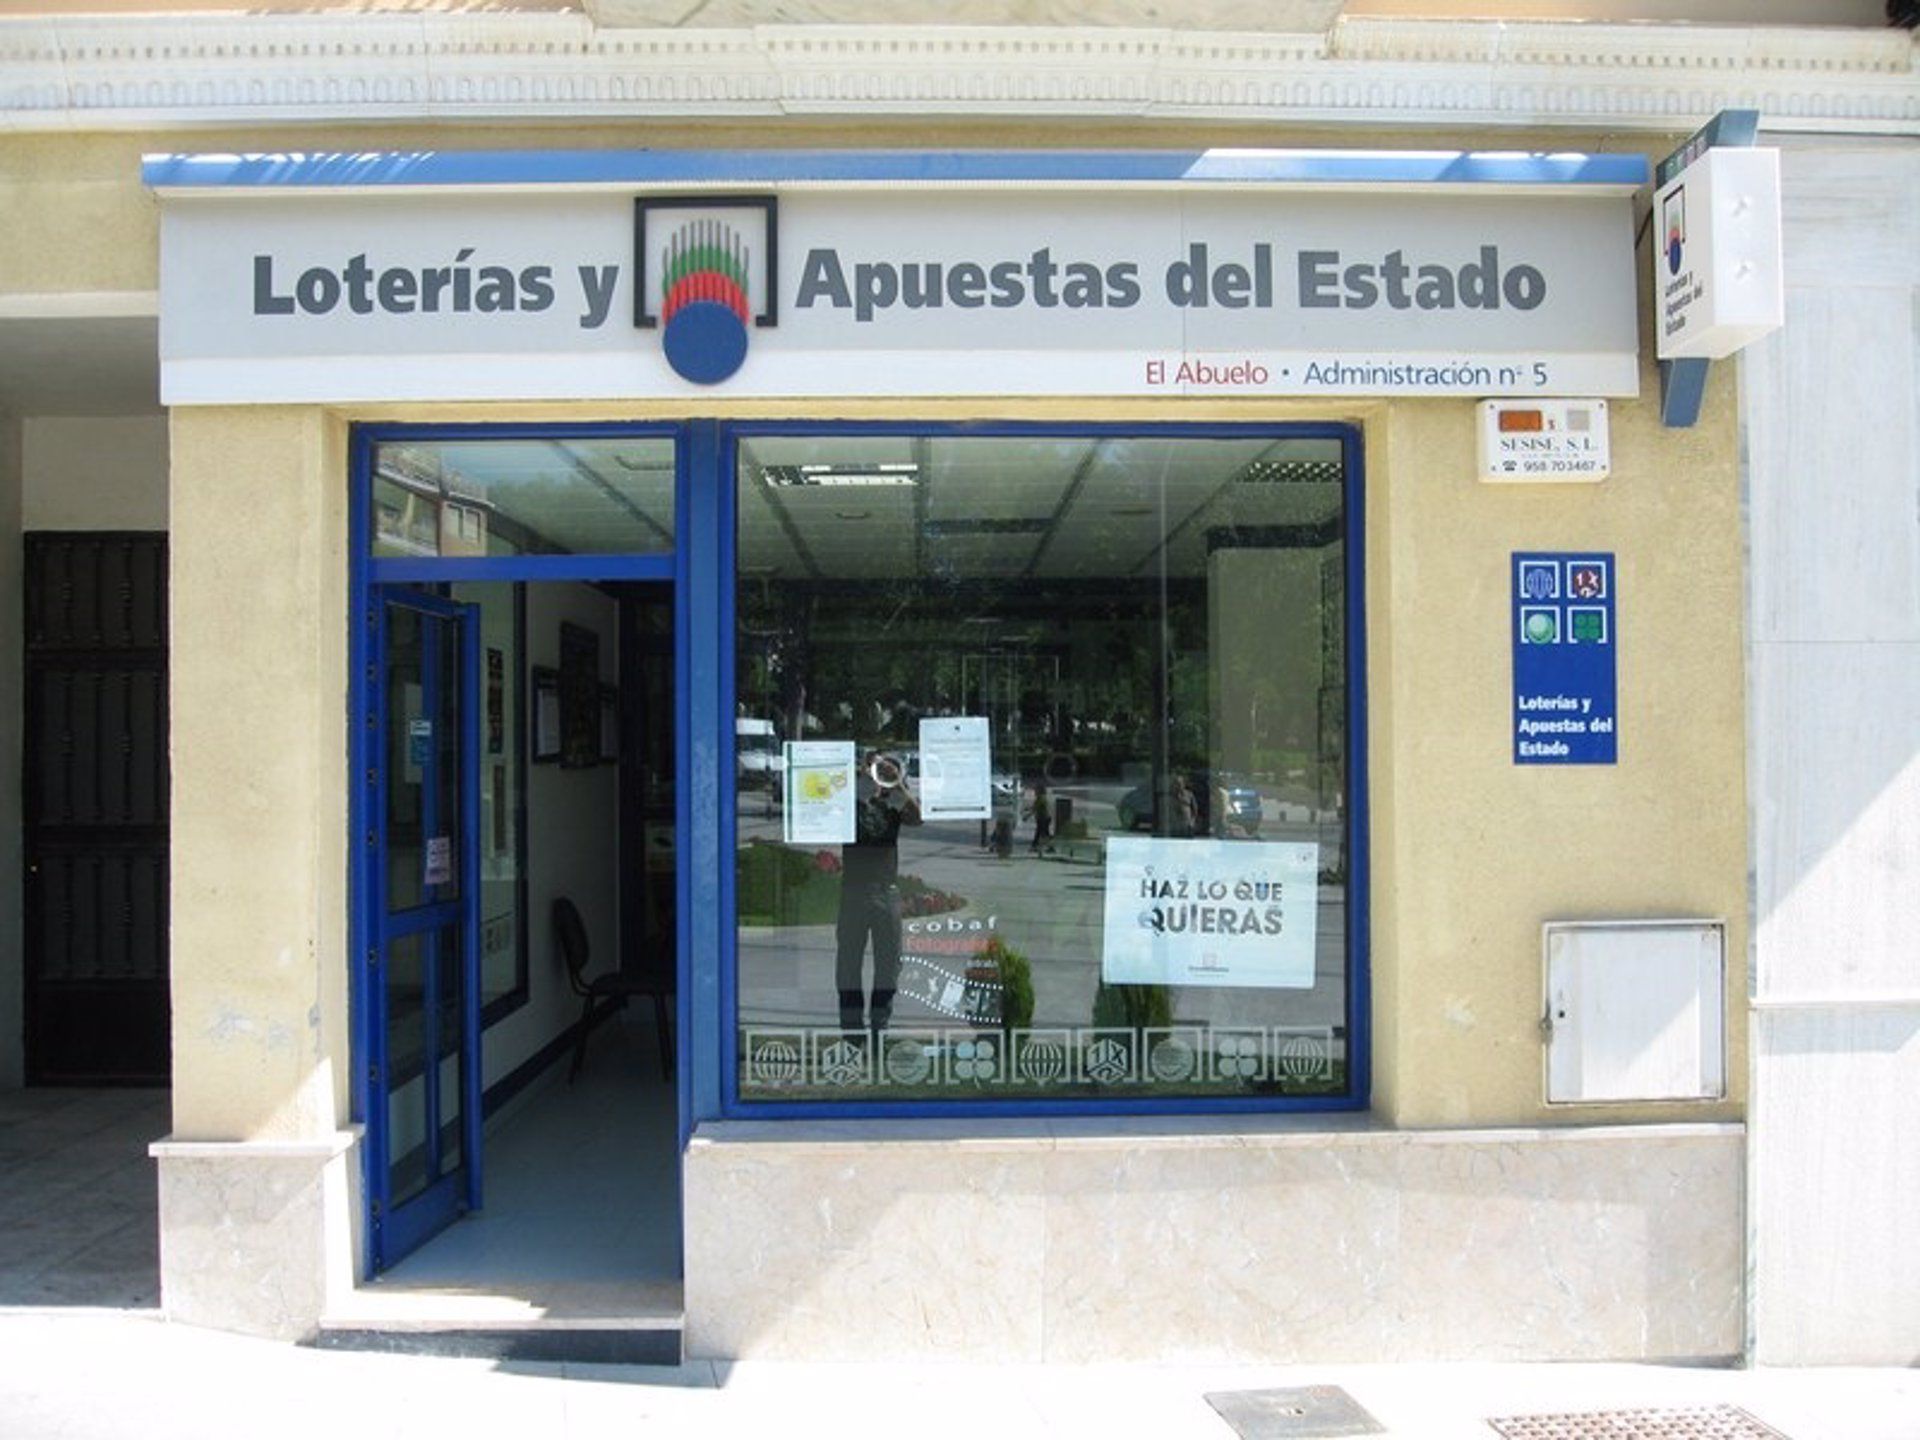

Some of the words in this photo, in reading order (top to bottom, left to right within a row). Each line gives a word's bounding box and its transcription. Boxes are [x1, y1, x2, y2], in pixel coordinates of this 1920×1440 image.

[254, 248, 556, 317] Loterías
[579, 265, 621, 330] y
[795, 248, 1142, 323] Apuestas
[1166, 243, 1274, 310] del
[1298, 245, 1548, 312] Estado
[1147, 361, 1166, 386] El
[1176, 360, 1270, 386] Abuelo
[1304, 361, 1493, 387] Administración
[1533, 362, 1549, 388] 5
[1523, 460, 1548, 473] 958
[1519, 696, 1579, 711] Loterías
[1581, 698, 1593, 714] y
[1519, 719, 1587, 737] Apuestas
[1590, 718, 1614, 734] del
[1519, 741, 1571, 757] Estado
[1140, 879, 1189, 900] HAZ
[1196, 880, 1228, 901] LO
[1233, 880, 1284, 902] QUE
[1138, 904, 1284, 937] QUIERAS
